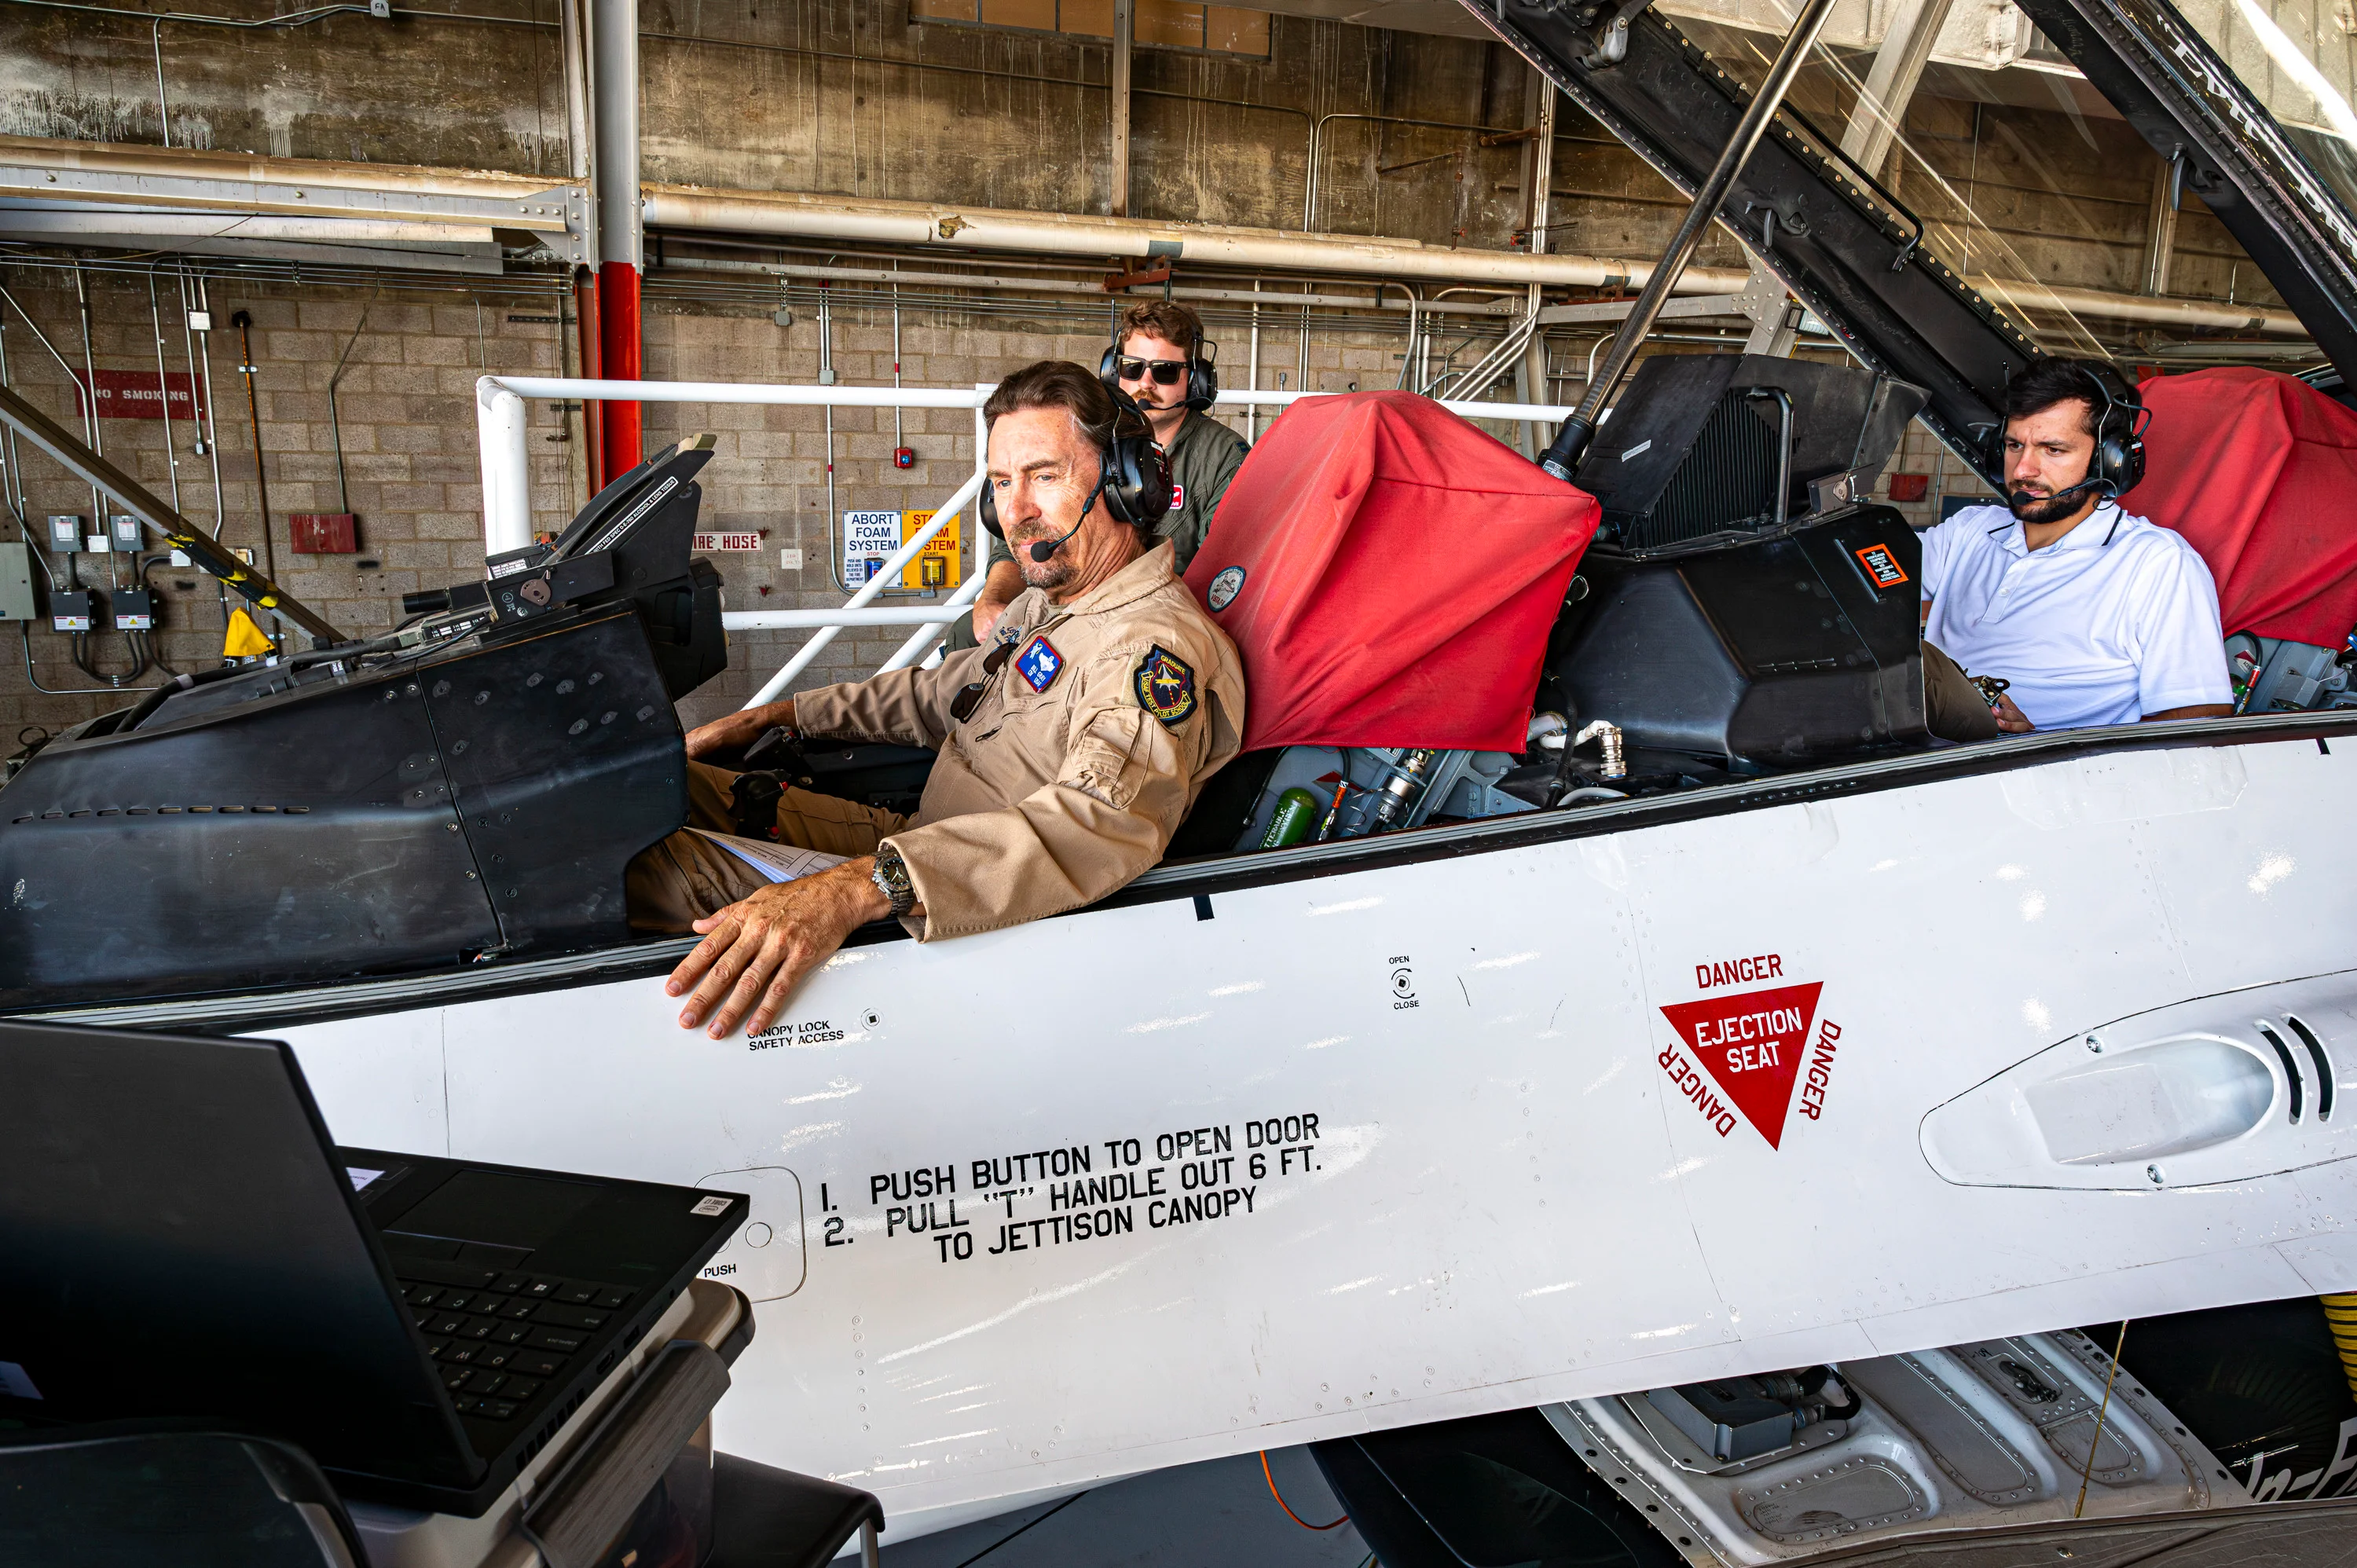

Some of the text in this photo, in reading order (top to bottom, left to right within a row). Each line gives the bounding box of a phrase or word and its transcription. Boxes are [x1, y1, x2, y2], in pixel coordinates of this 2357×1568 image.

[123, 390, 189, 401] SMOKNG
[661, 479, 676, 493] TISSUE
[852, 514, 894, 525] ABORT
[856, 527, 890, 537] FOAM
[693, 536, 757, 549] IRE HOSE
[849, 540, 897, 551] SYSTEM
[924, 540, 955, 551] STEM
[1160, 655, 1186, 675] GRADUATE
[1146, 694, 1156, 709] TEST
[1154, 708, 1170, 717] PILOT
[1171, 701, 1189, 715] SCHOOL
[1389, 955, 1409, 965] OPEN
[1695, 954, 1783, 989] DANGER
[1394, 1000, 1420, 1010] CLOSE
[798, 1020, 830, 1033] LOCK
[1695, 1006, 1803, 1047] EJECTION
[749, 1030, 845, 1051] SAFETY ACCESS
[1726, 1041, 1780, 1073] SEAT
[1798, 1019, 1842, 1121] DANGER
[1658, 1043, 1737, 1138] DANGER
[822, 1112, 1320, 1211] 1. PUSH BUTTON TO OPEN DOOR
[823, 1216, 854, 1247] 2.
[886, 1200, 969, 1238] PULL
[1050, 1167, 1166, 1211] HANDLE
[1181, 1157, 1234, 1190] OUT
[1248, 1153, 1266, 1179] 6
[1281, 1145, 1321, 1176] FT.
[933, 1185, 1257, 1263] TO JETTISON CANOPY
[704, 1263, 737, 1278] PUSH
[516, 1308, 528, 1317] Z
[456, 1351, 471, 1360] W
[493, 1356, 504, 1365] Q
